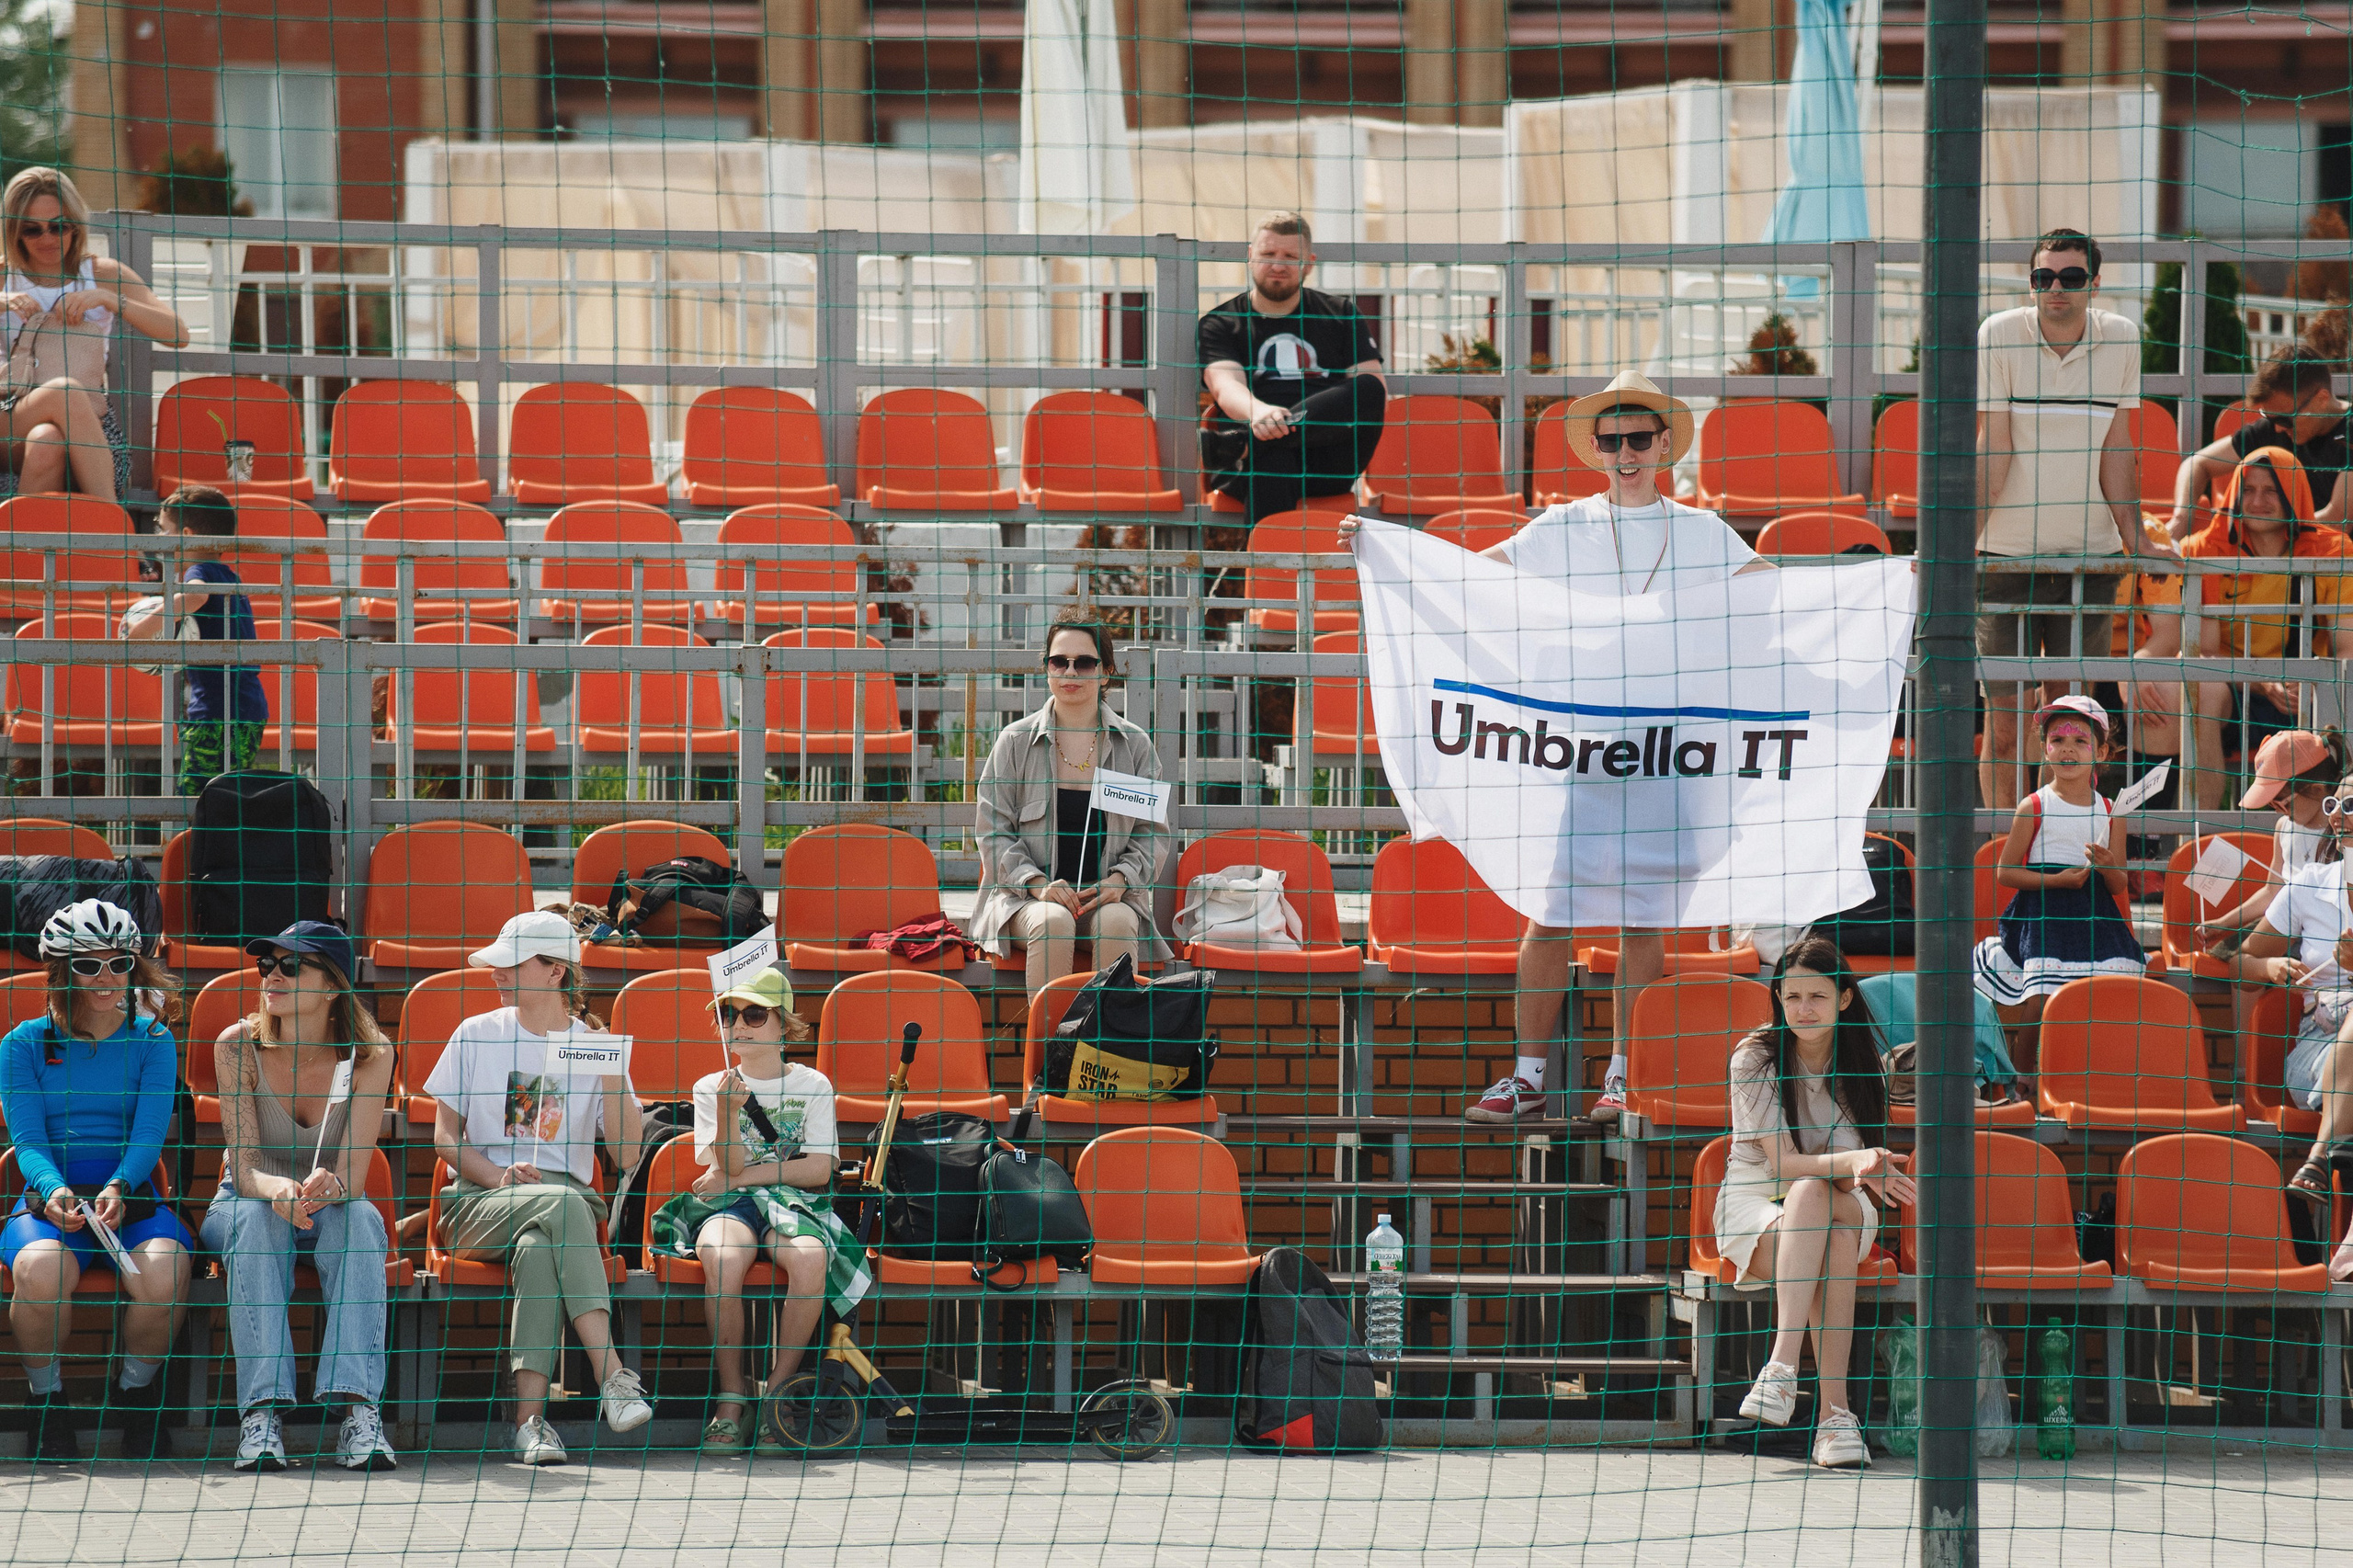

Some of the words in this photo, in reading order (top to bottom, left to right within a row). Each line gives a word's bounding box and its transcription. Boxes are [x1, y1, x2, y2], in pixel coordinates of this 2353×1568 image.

[1431, 699, 1716, 778] Umbrella
[1738, 730, 1808, 780] IT
[1104, 788, 1145, 804] Umbrella
[1147, 797, 1158, 807] IT
[722, 952, 760, 977] Umbrella
[761, 944, 768, 956] IT
[558, 1050, 606, 1062] Umbrella
[608, 1052, 620, 1062] IT
[1080, 1060, 1109, 1081] IRON
[1077, 1074, 1119, 1100] STAR
